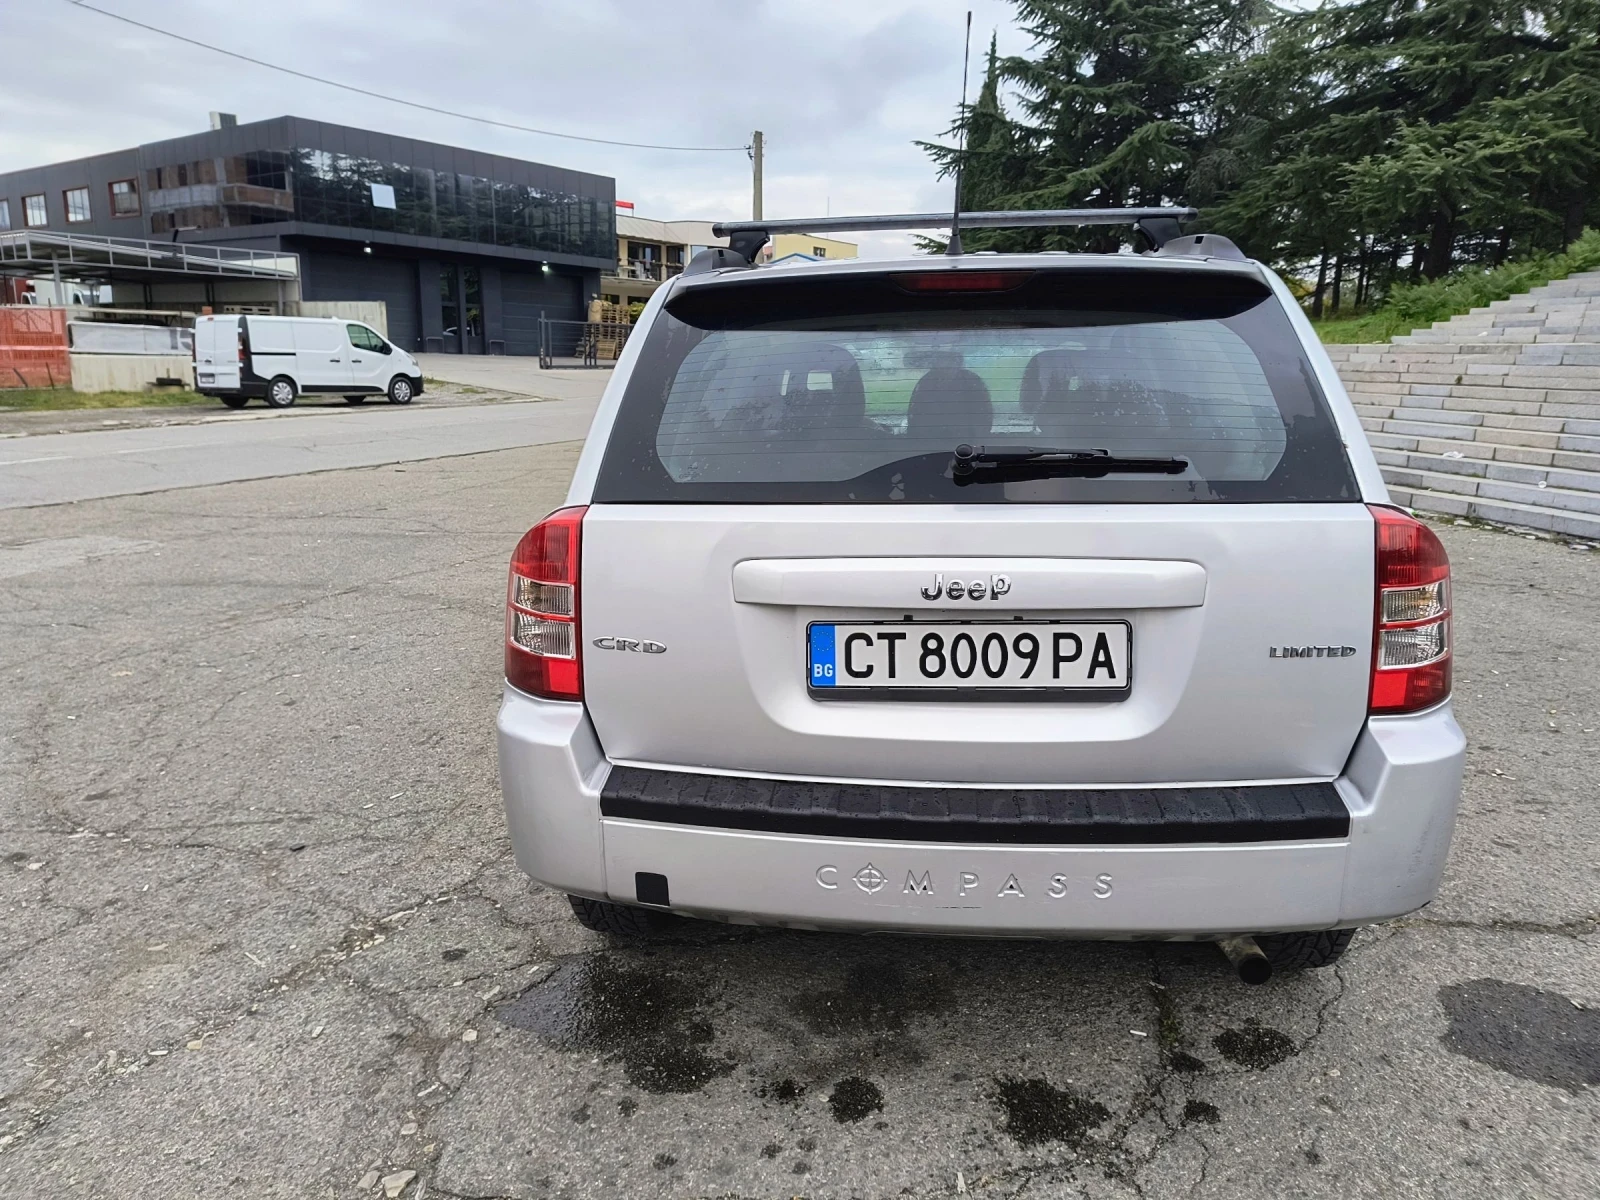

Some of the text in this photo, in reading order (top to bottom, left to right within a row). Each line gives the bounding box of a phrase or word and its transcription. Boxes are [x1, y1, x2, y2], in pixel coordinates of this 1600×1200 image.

[921, 573, 1012, 601] Jeep
[592, 636, 668, 654] CRD
[1269, 645, 1357, 658] LIMITED
[844, 632, 1117, 679] CT 8009 PA
[813, 663, 833, 677] BG
